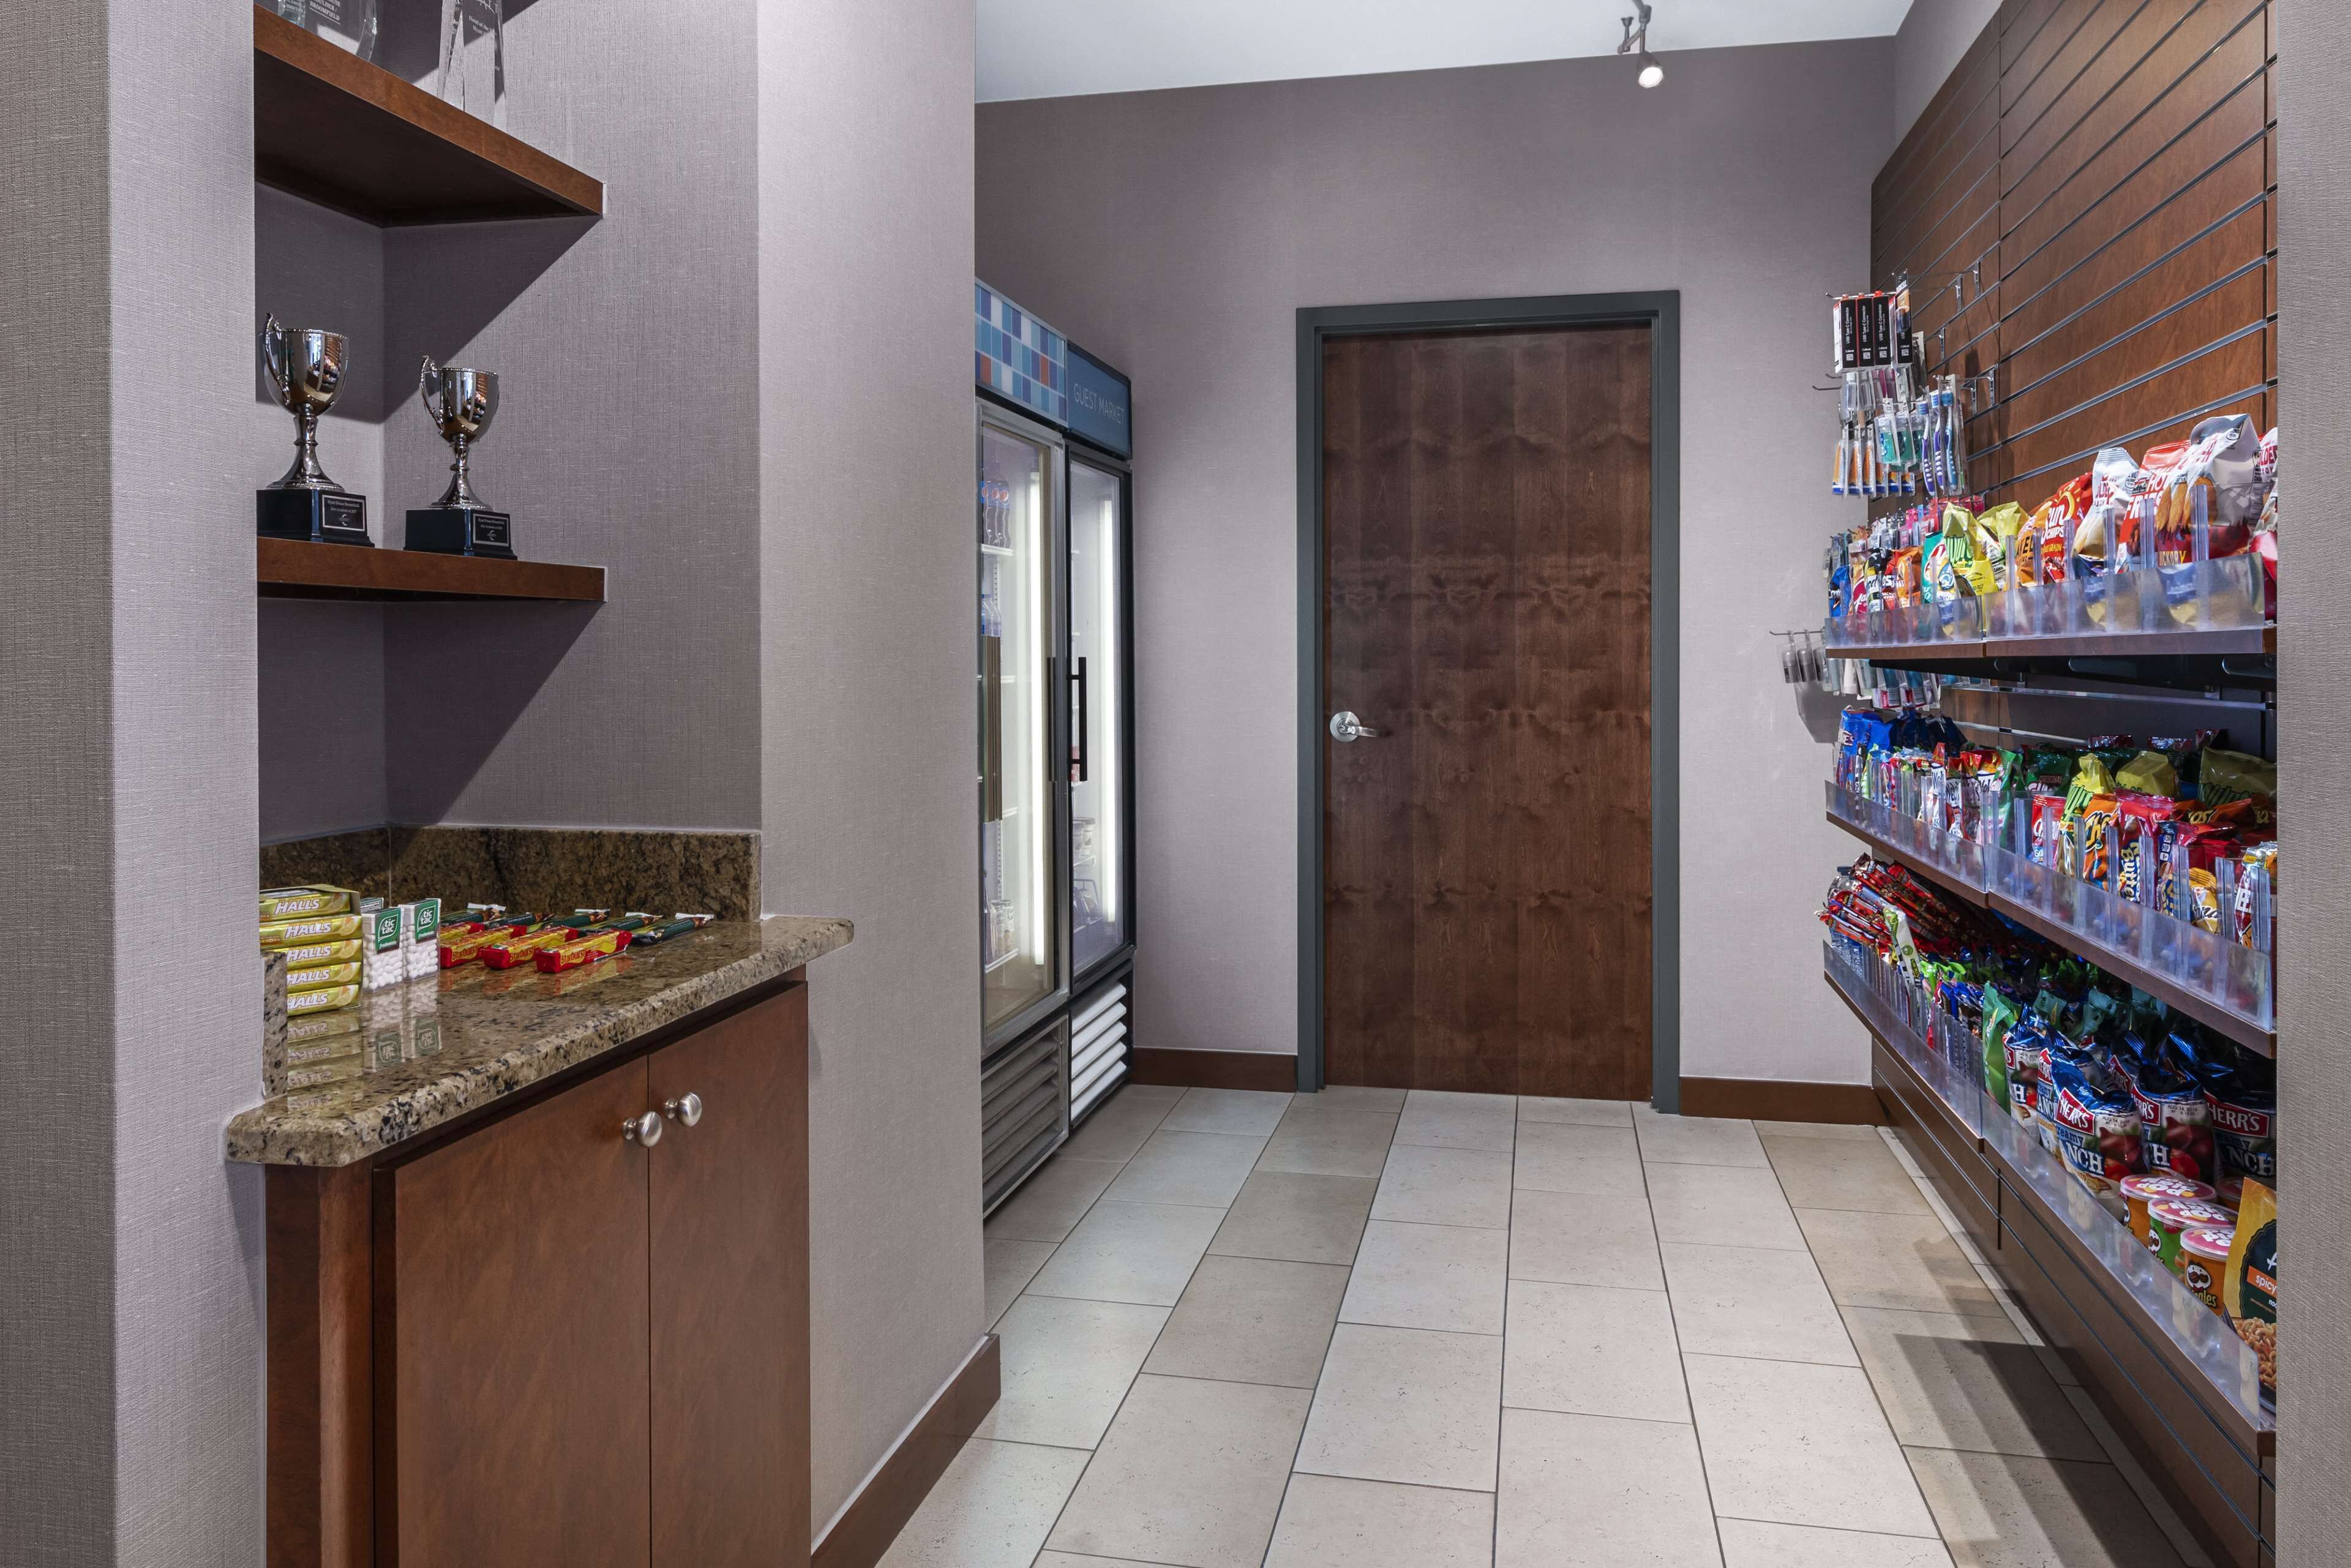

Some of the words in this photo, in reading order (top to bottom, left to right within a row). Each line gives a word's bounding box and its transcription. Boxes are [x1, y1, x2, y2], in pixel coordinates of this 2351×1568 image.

[309, 1, 340, 21] BROOMFIELD
[1074, 383, 1097, 411] GUEST
[1099, 397, 1125, 426] MARKET
[2123, 493, 2163, 520] FRS
[2046, 526, 2064, 540] CHIPS
[274, 898, 320, 915] HALLS
[423, 909, 433, 918] tic
[285, 922, 332, 939] HALLS
[381, 926, 395, 934] tac
[385, 918, 396, 928] tic
[287, 945, 332, 962] HALLS
[287, 969, 331, 986] HALLS
[287, 992, 329, 1010] HALLS
[2060, 1096, 2090, 1128] HERR'S
[2207, 1101, 2260, 1132] HERR'S
[2061, 1140, 2105, 1176] NCH
[2227, 1145, 2276, 1176] NCH
[2255, 1275, 2277, 1294] spicy
